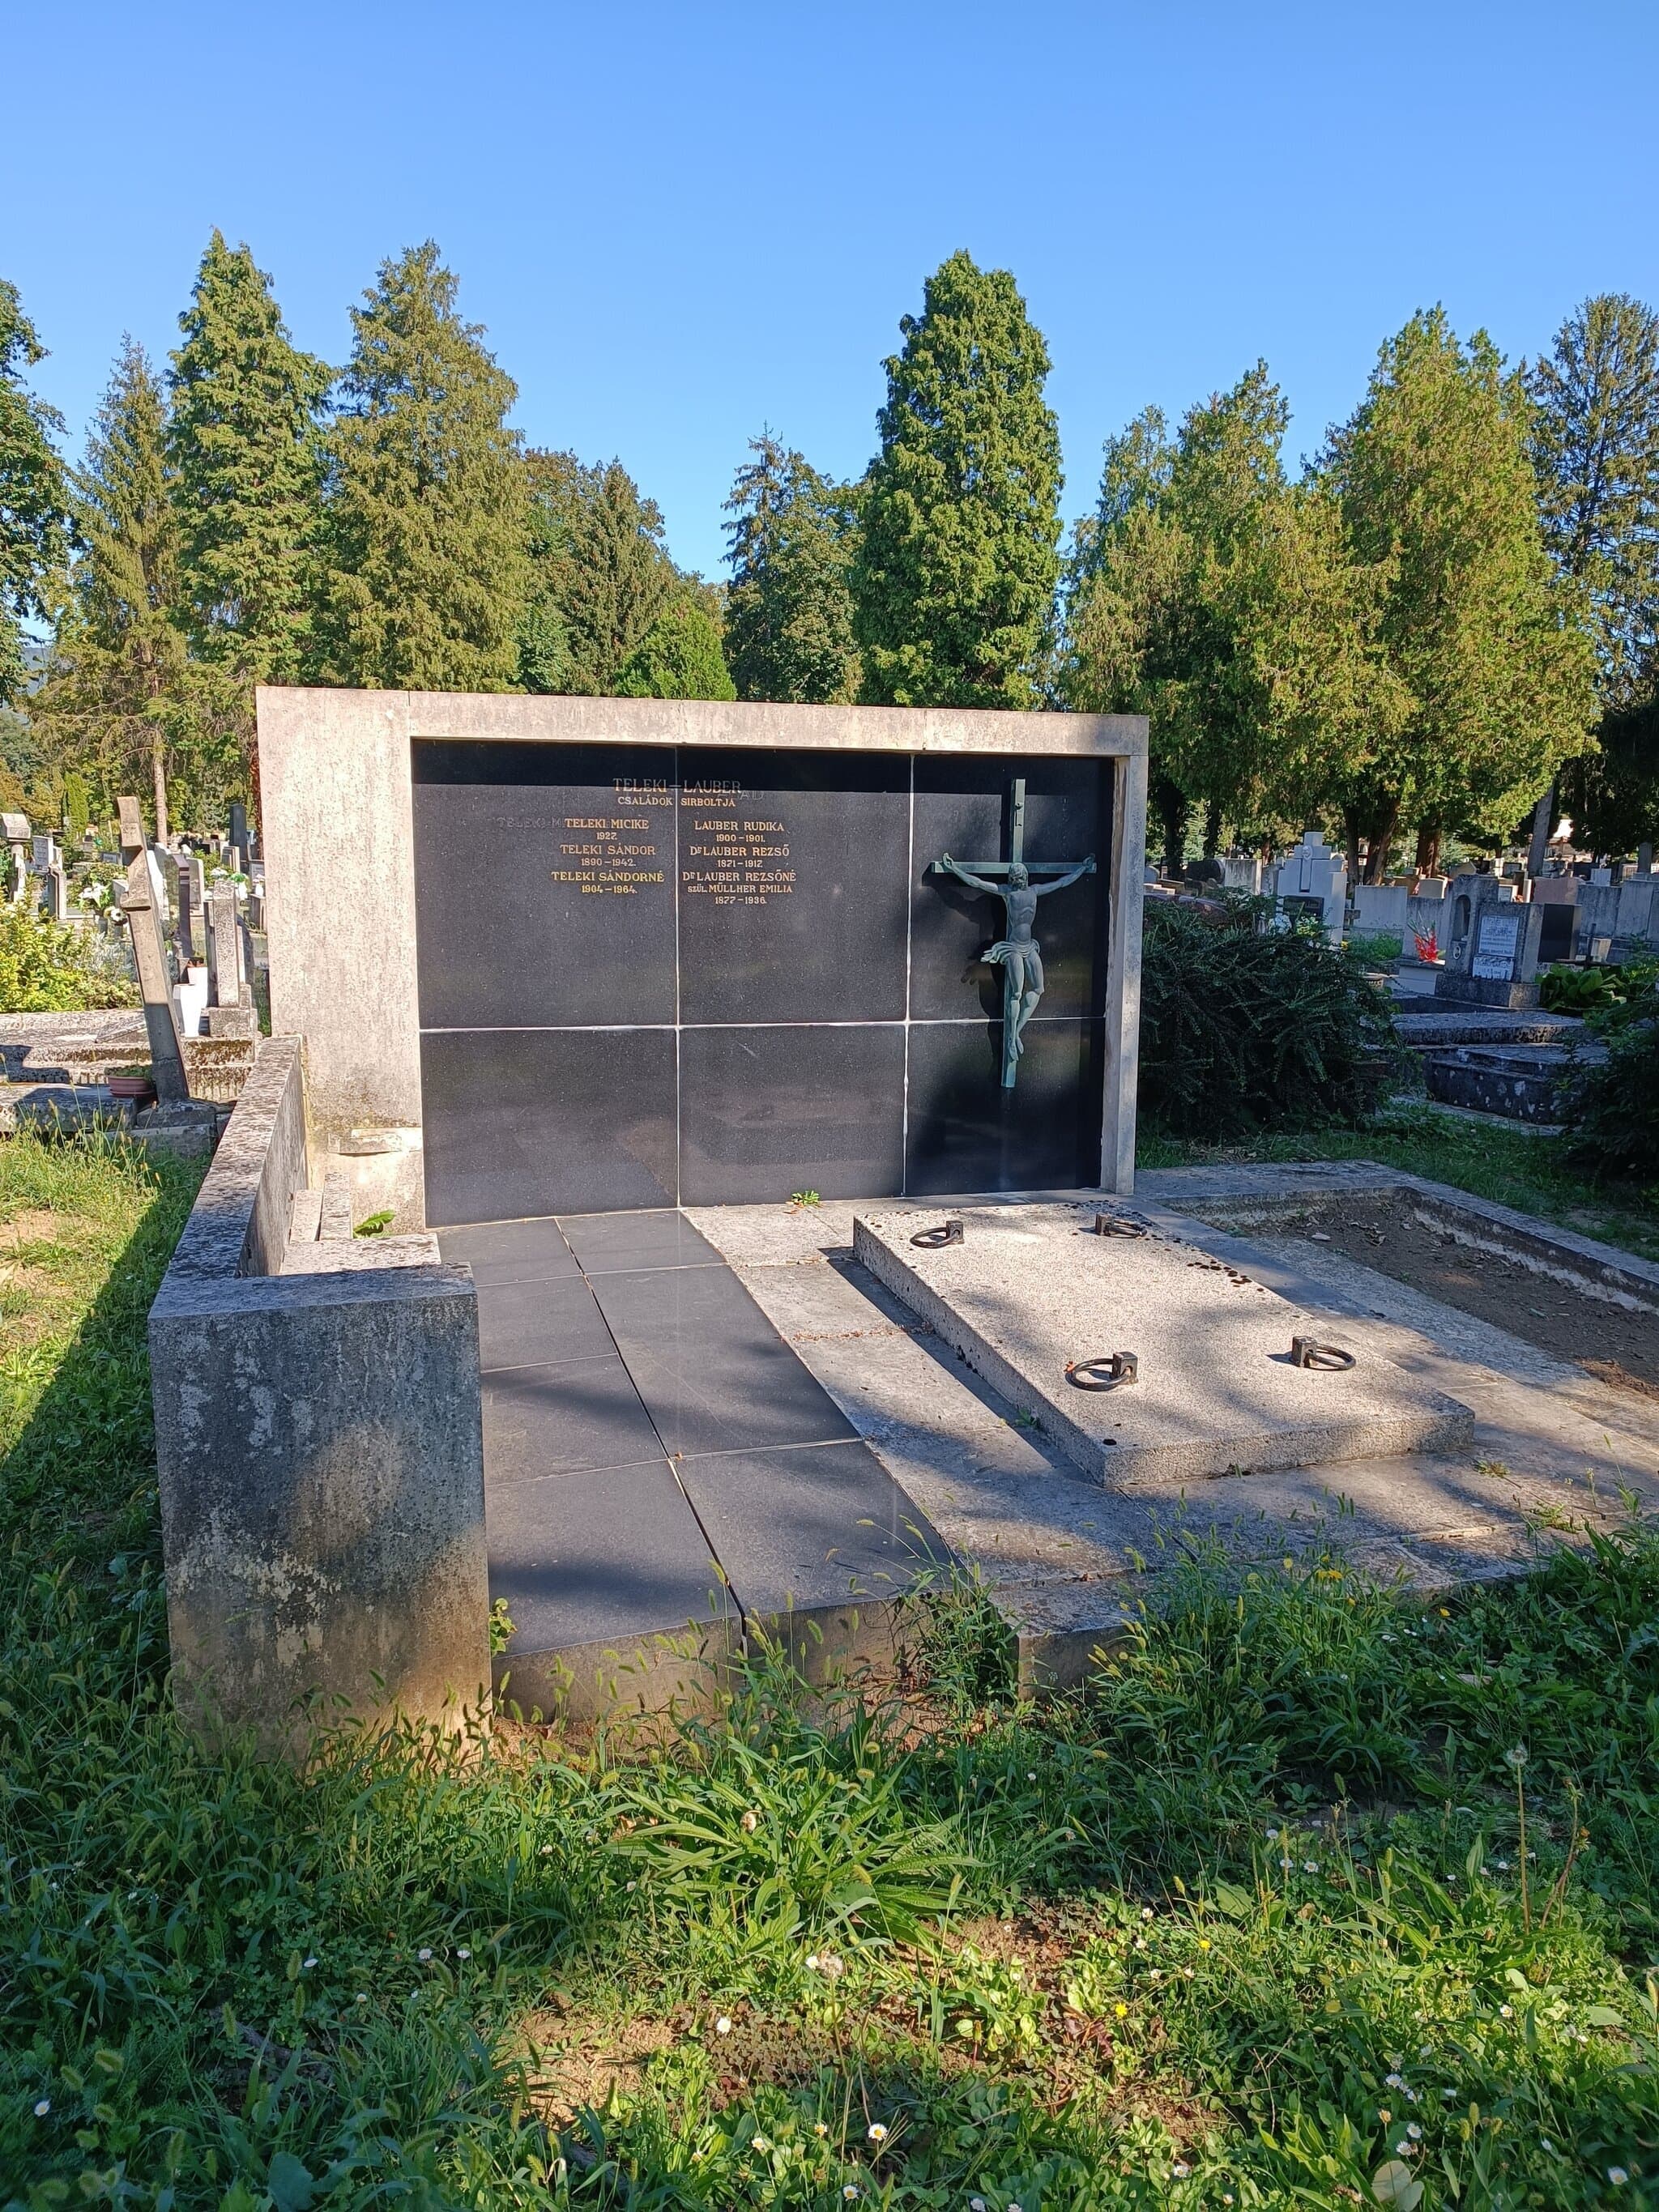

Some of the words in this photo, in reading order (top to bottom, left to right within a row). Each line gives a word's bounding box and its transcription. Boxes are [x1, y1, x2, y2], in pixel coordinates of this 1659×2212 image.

[617, 794, 673, 808] CSALÁDOK
[564, 818, 607, 829] TELEKI
[611, 818, 650, 829] MICIKE
[694, 820, 739, 831] LAUBER
[744, 821, 785, 832] RUDIKA
[560, 844, 602, 855] TELEKI
[607, 842, 657, 856] SÁNDOR
[702, 846, 747, 857] LAUBER
[752, 843, 791, 857] REZSŐ
[551, 871, 595, 881] TELEKI
[598, 869, 665, 883] SÁNDORNÉ
[696, 872, 740, 882] LAUBER
[745, 868, 797, 882] REZSŐNÉ
[759, 884, 793, 893] EMILIA
